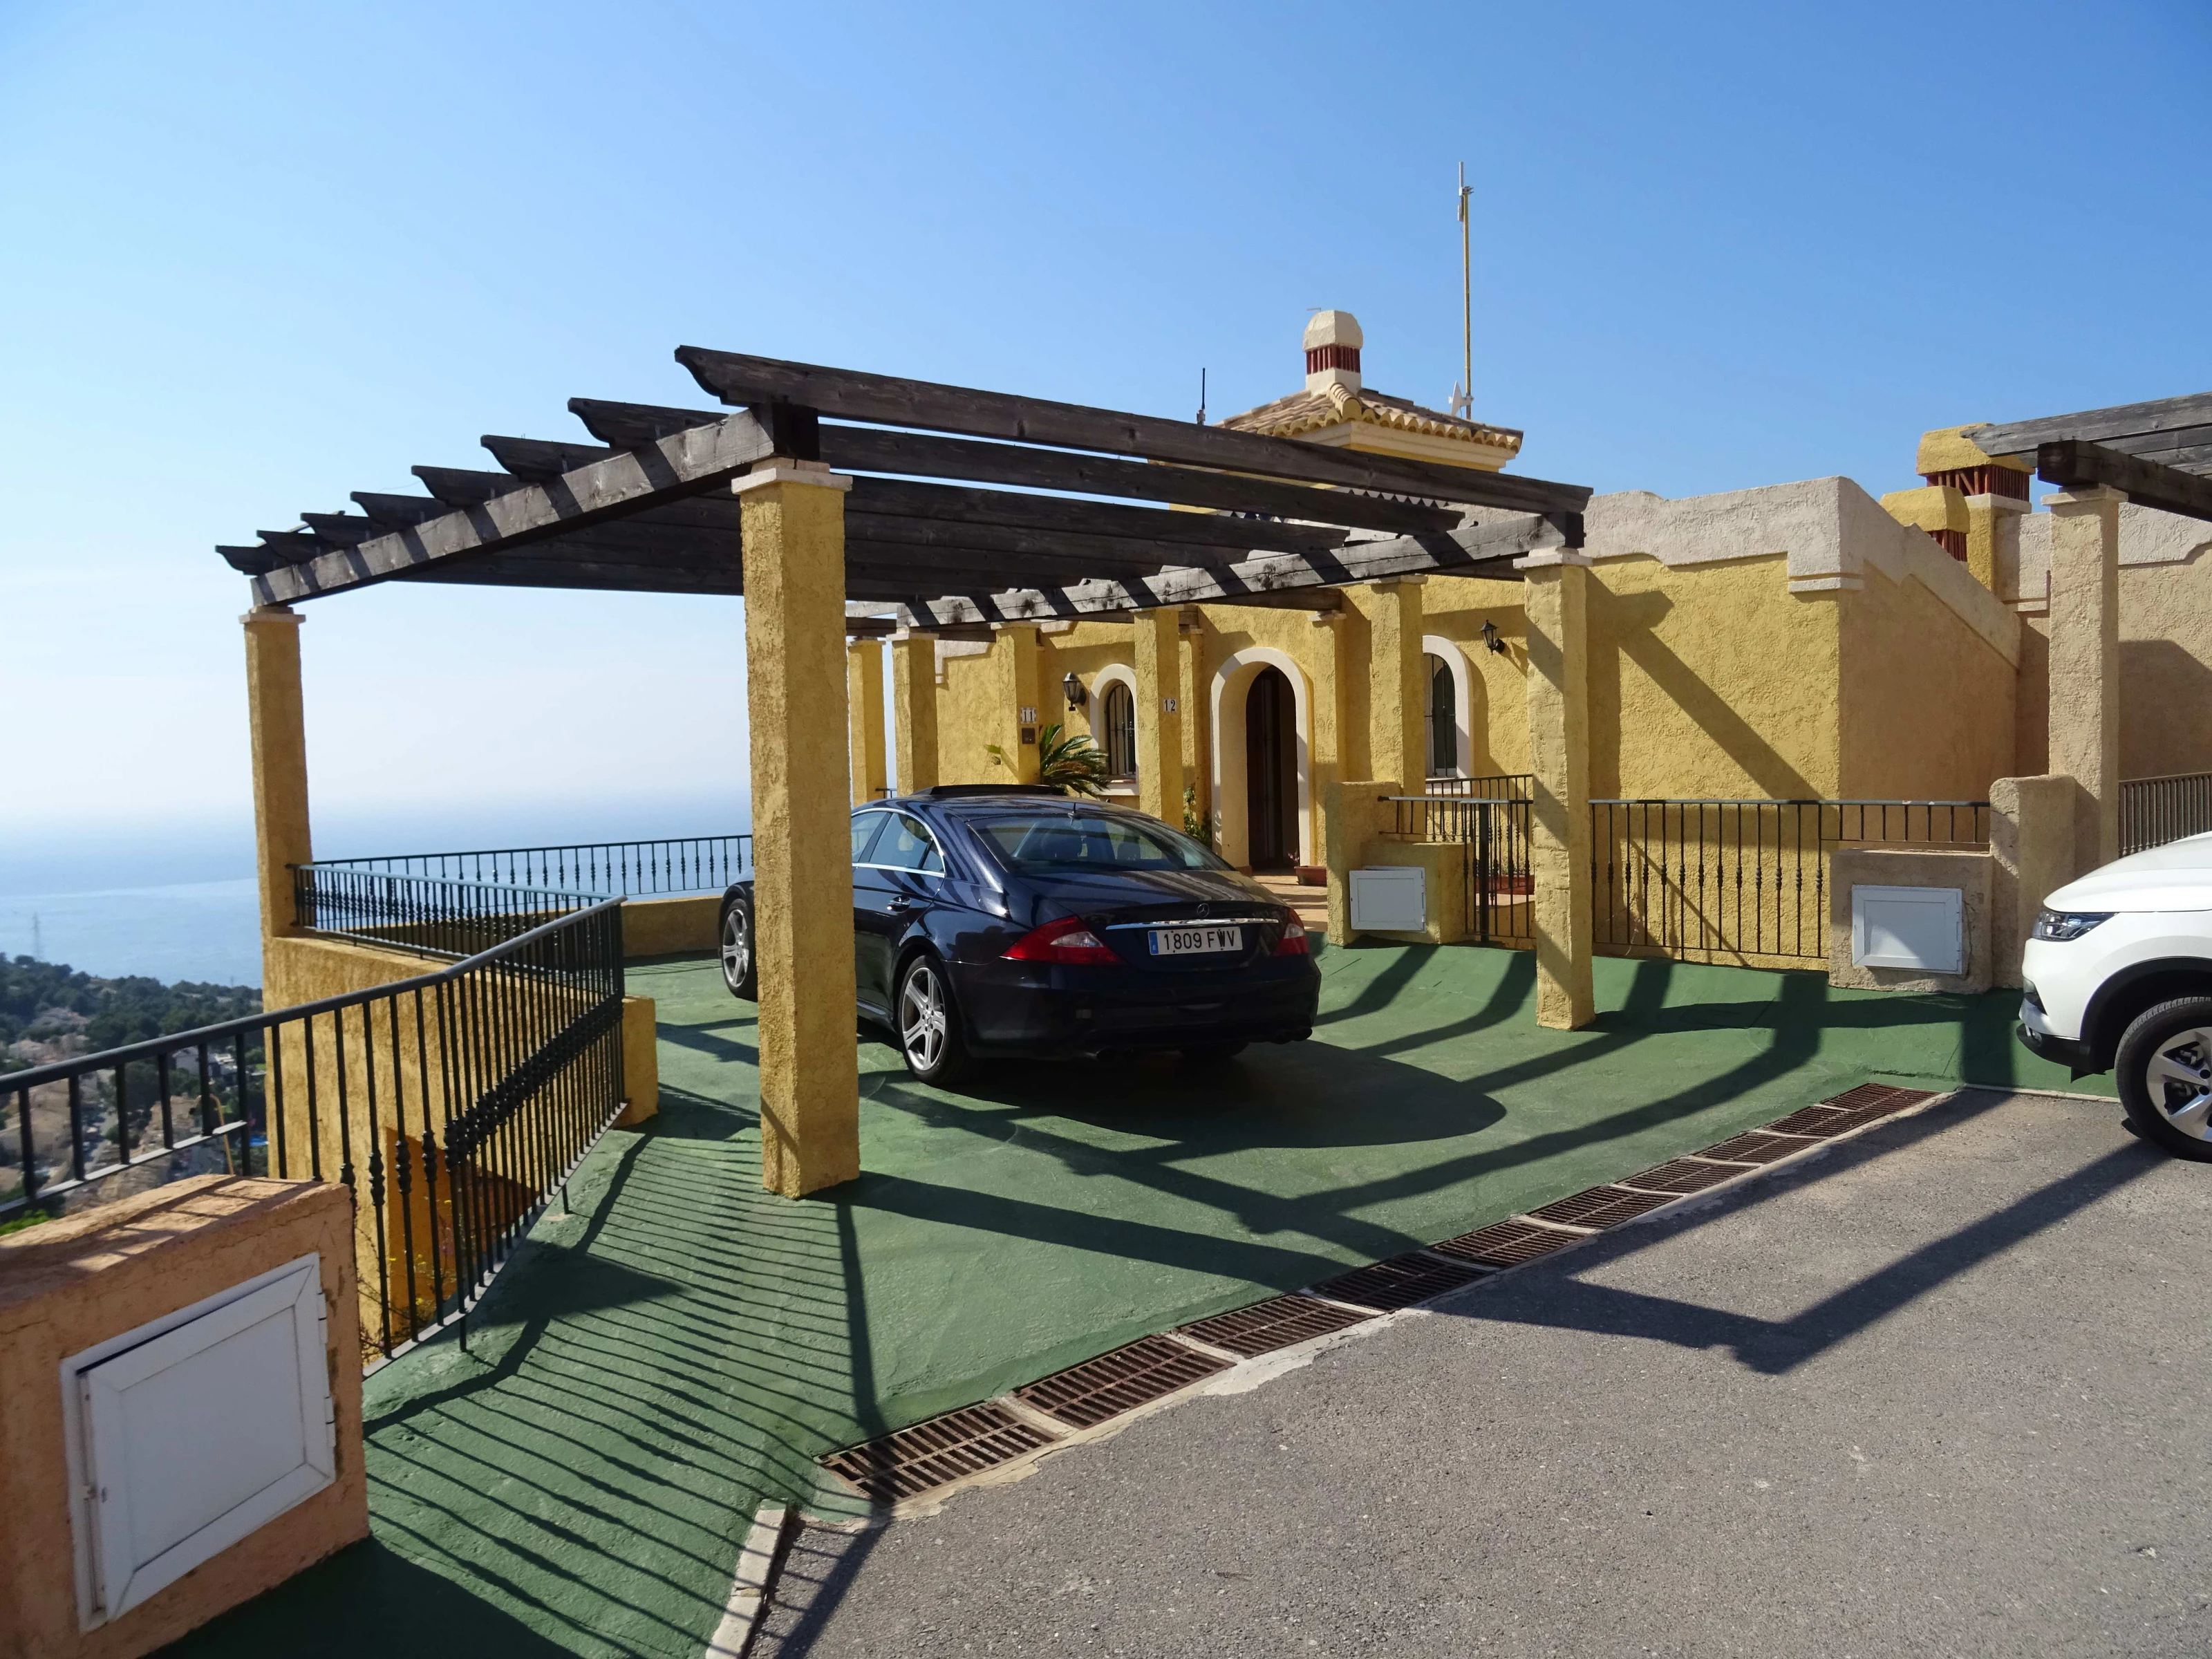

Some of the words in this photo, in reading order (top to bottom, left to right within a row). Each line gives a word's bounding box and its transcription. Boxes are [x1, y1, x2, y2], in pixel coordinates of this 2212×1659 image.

[1165, 700, 1175, 711] 12
[1024, 711, 1033, 722] 11
[1164, 932, 1202, 950] 1809
[1207, 930, 1235, 948] FWV
